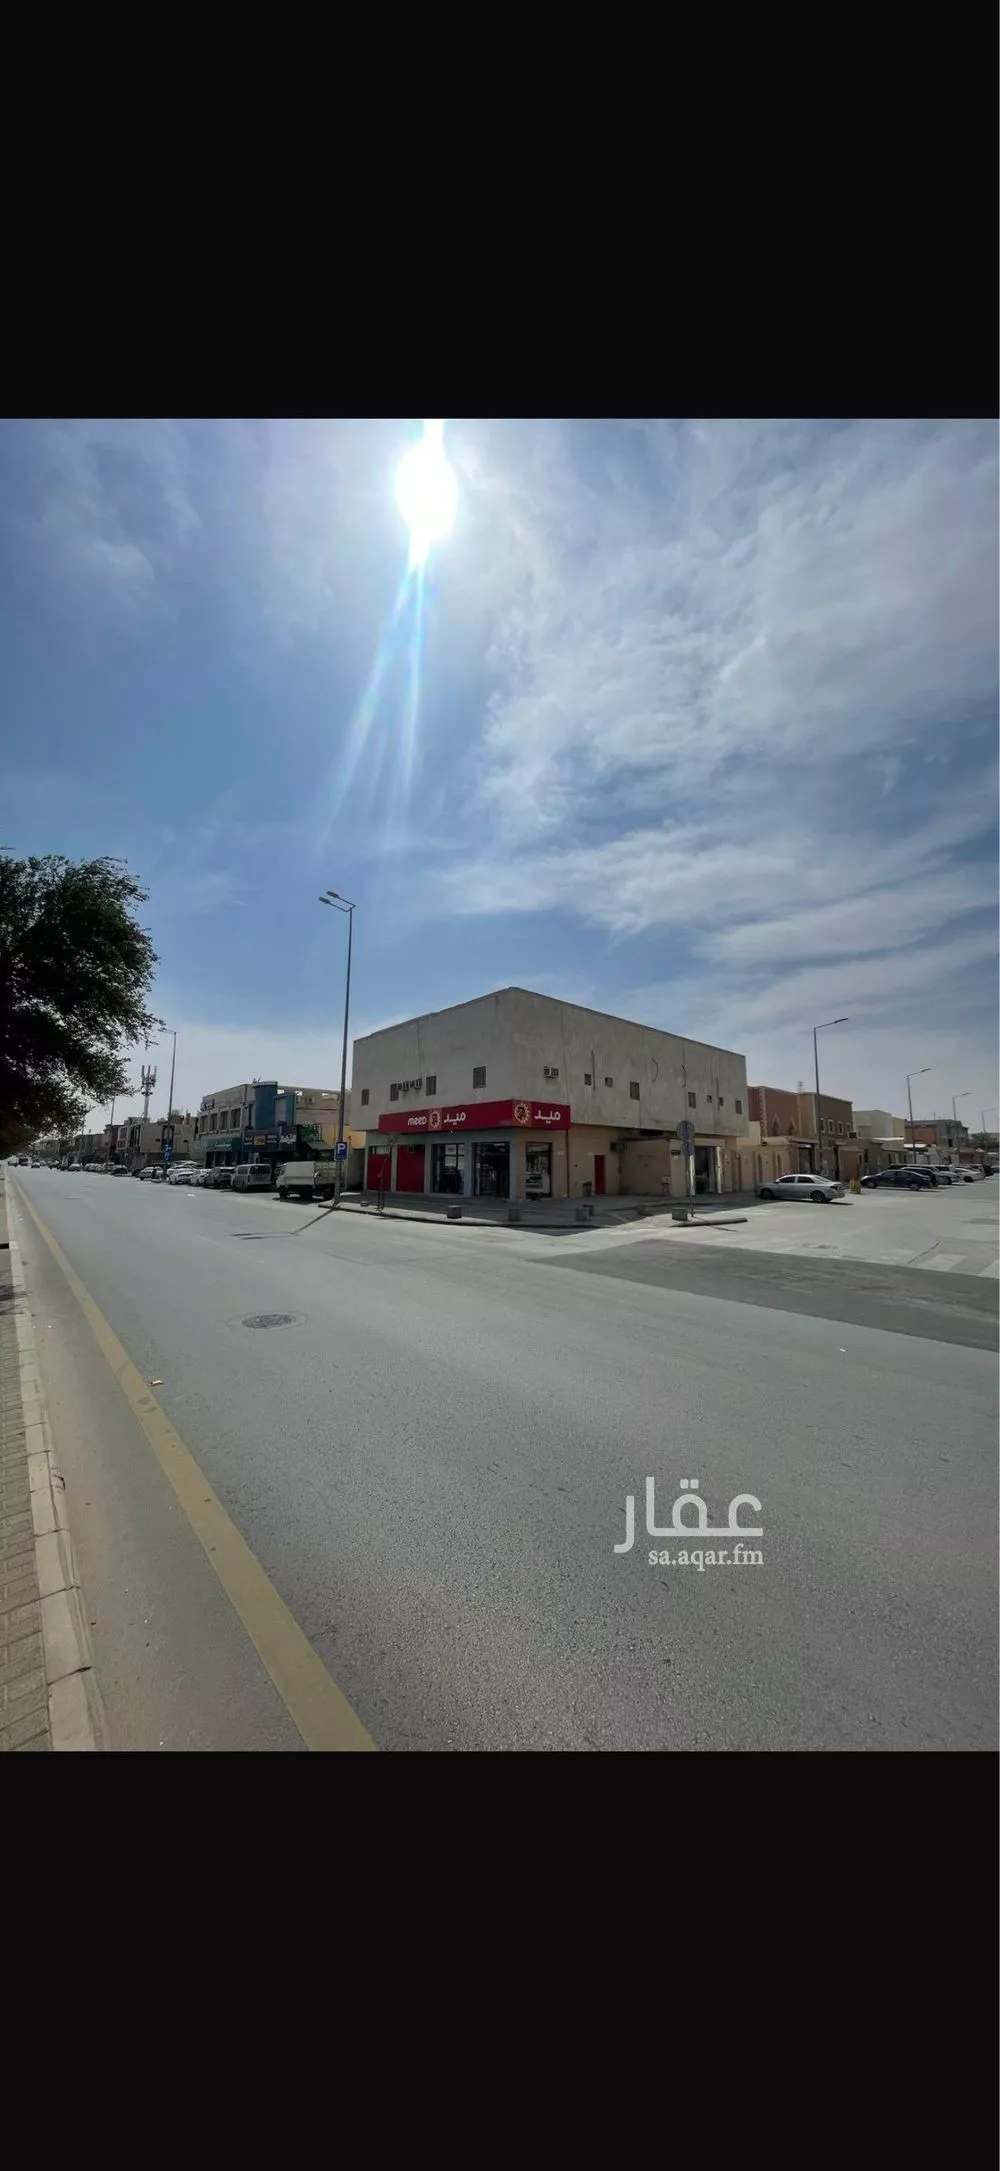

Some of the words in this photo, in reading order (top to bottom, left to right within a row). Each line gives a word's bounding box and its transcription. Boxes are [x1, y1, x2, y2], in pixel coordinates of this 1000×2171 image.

[444, 1112, 466, 1125] ميد
[534, 1109, 561, 1124] ميد
[337, 1143, 346, 1154] P
